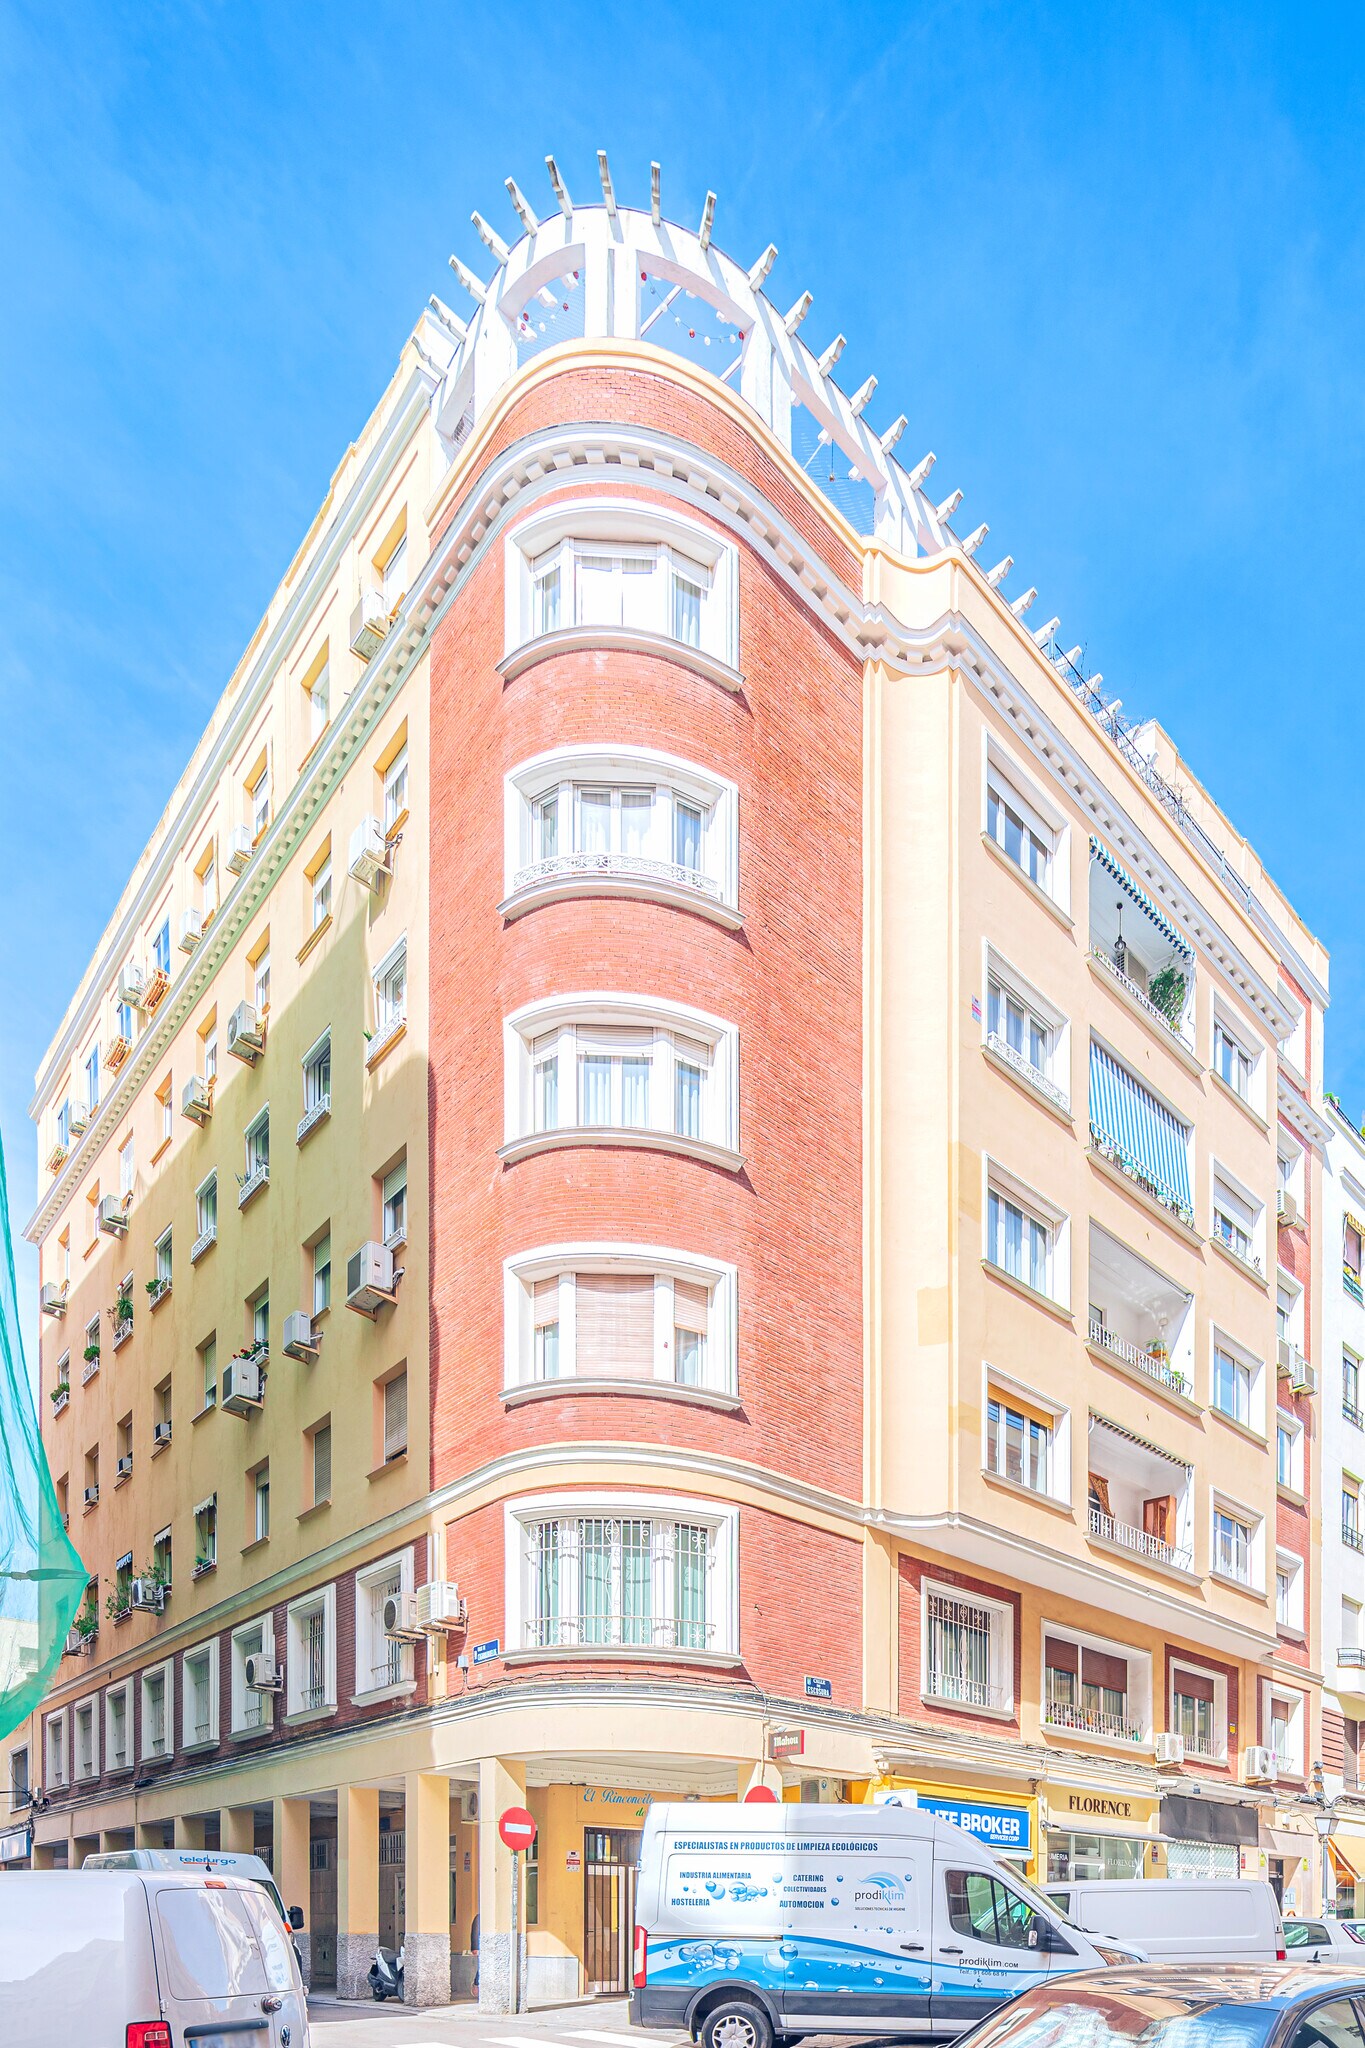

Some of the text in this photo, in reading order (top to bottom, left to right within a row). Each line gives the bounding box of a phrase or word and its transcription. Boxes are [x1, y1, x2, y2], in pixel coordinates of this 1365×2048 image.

[583, 1787, 655, 1805] El Rinconcito
[1069, 1795, 1131, 1817] FLORENCE
[960, 1812, 1020, 1836] BROKER
[674, 1840, 878, 1852] ESPECIALISTAS EN PRODUCTOS DE LIMPIEZA ECOLÓGICOS
[179, 1856, 237, 1866] telefurgo
[679, 1871, 752, 1880] INDUSTRIA ALIMENTARIA
[792, 1874, 824, 1882] CATERING
[671, 1898, 710, 1906] HOSTELERIA
[854, 1890, 905, 1905] prodiklim
[779, 1900, 825, 1908] AUTOMOCION
